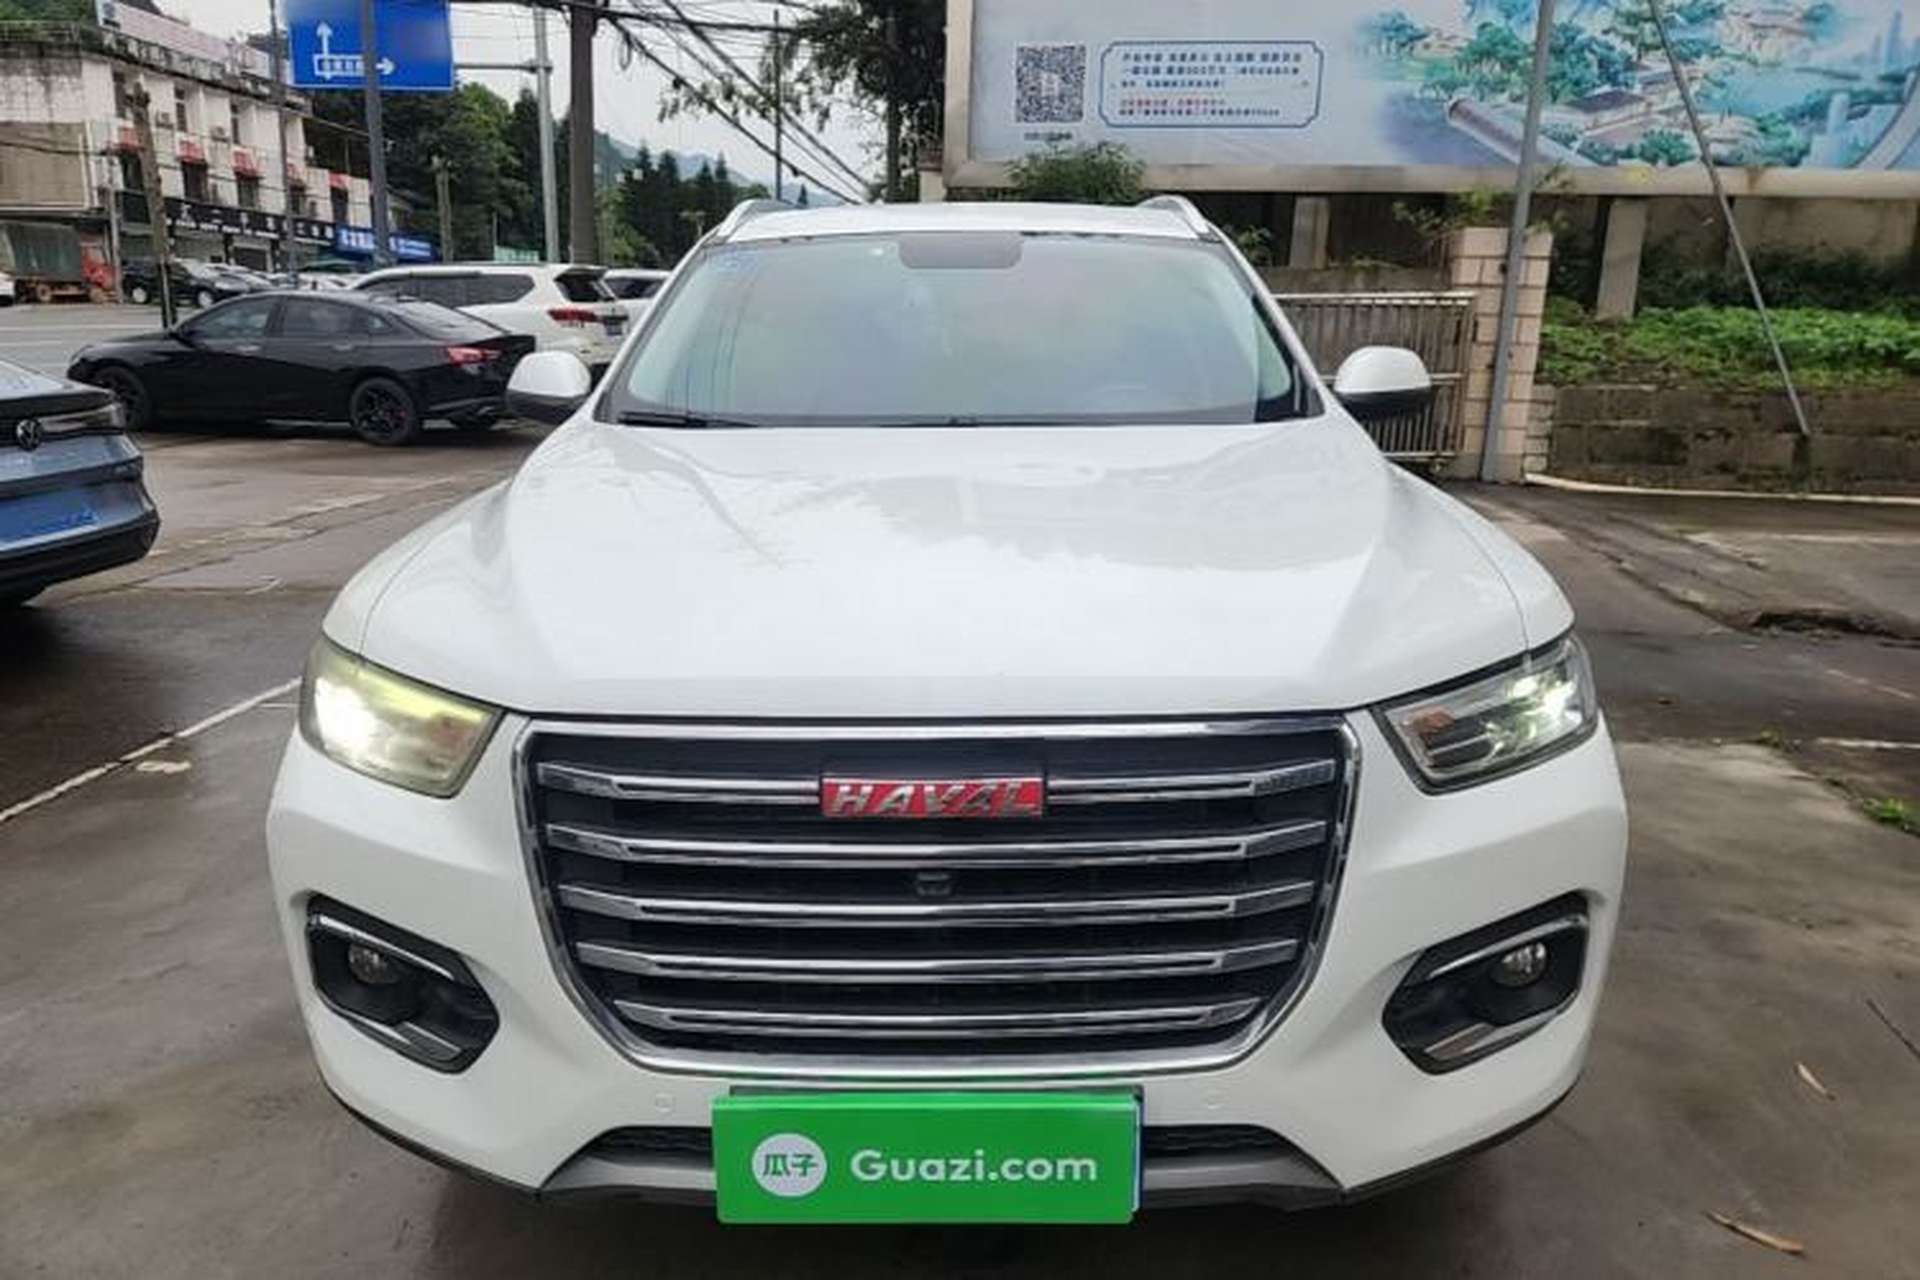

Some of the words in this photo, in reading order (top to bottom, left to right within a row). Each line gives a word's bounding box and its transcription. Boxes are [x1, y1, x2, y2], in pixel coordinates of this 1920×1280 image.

[832, 784, 1040, 816] HAVAL
[763, 1151, 818, 1179] 瓜子
[850, 1150, 1097, 1181] Guazi.com
